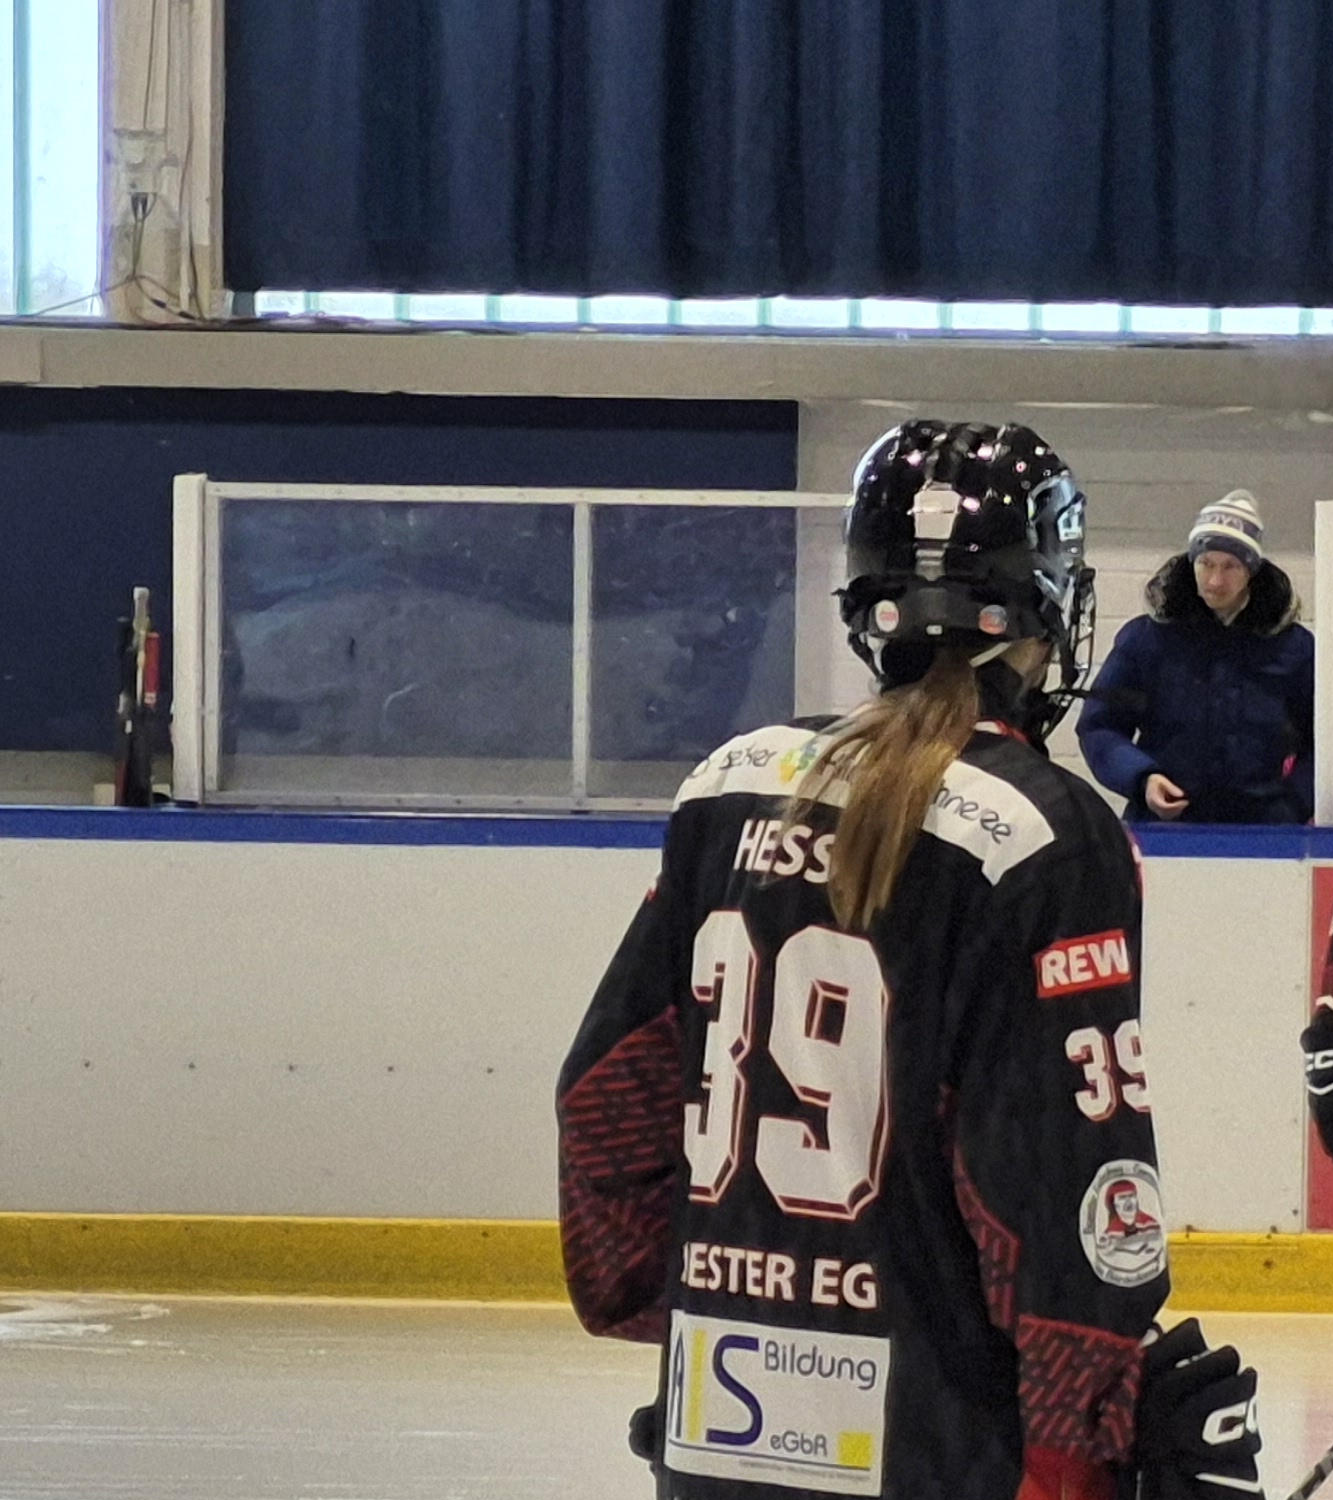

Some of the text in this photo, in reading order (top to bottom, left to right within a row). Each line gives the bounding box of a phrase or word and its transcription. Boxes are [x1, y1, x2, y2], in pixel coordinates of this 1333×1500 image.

[683, 908, 893, 1222] 39
[1064, 1019, 1152, 1122] 39
[681, 1241, 878, 1309] ESTER EG
[764, 1340, 878, 1391] Bildung
